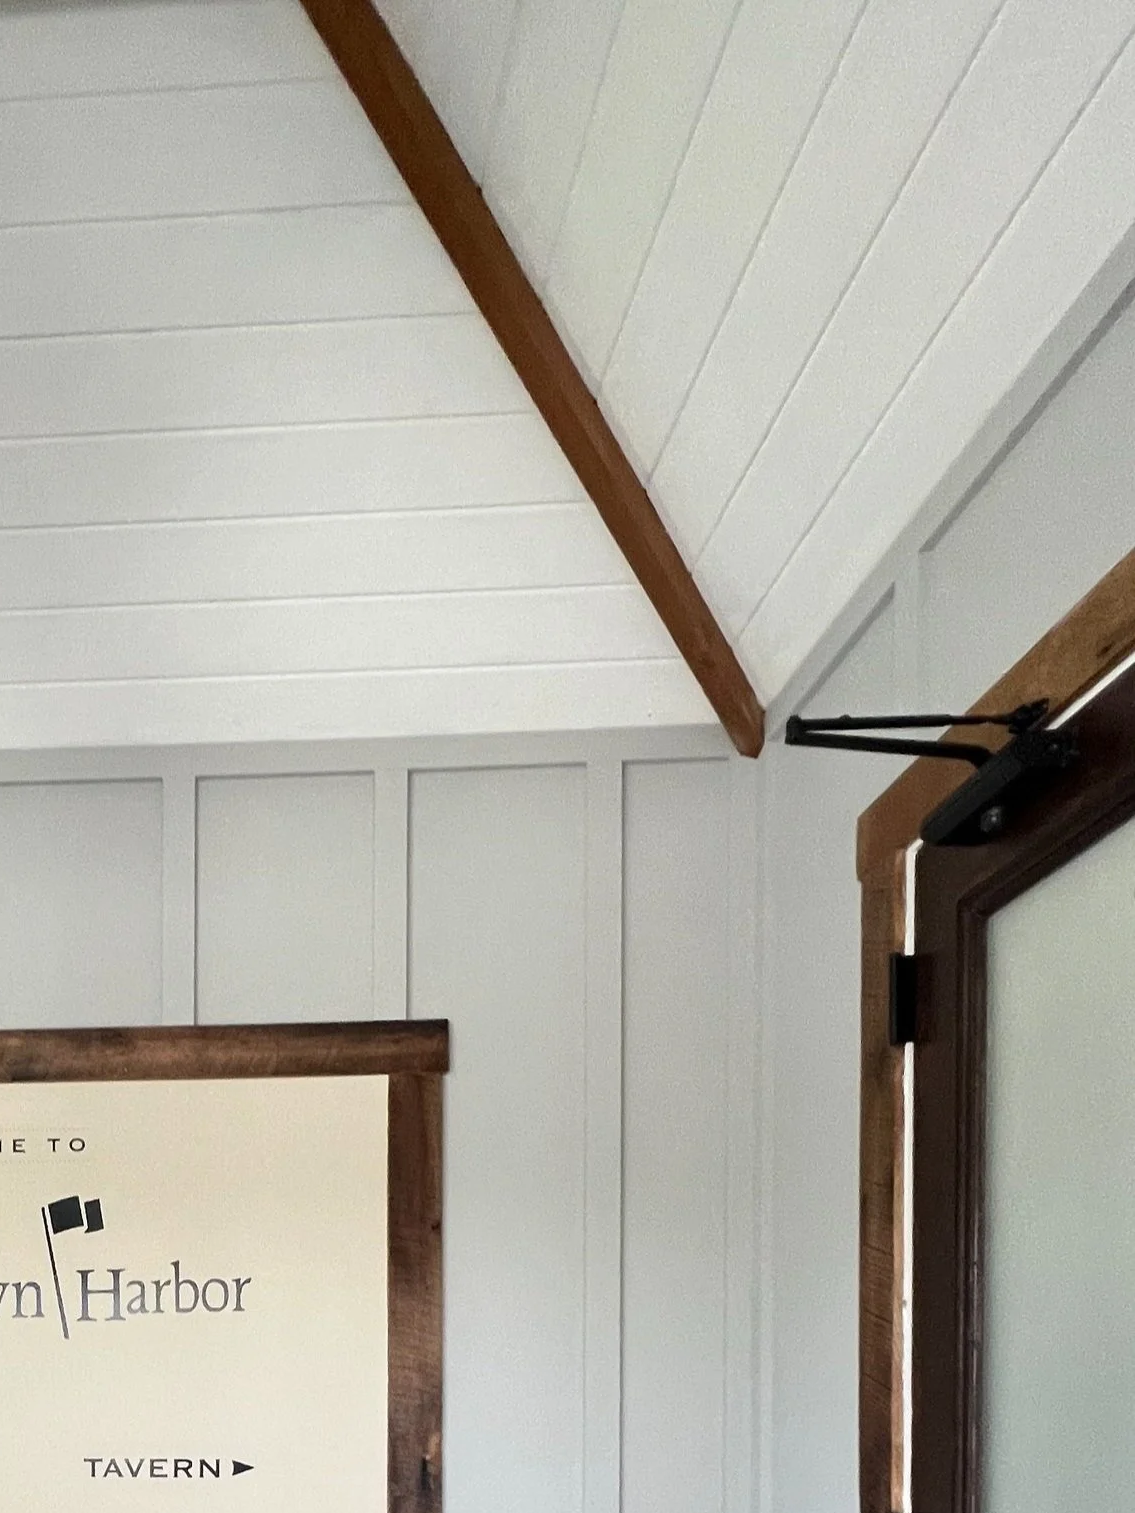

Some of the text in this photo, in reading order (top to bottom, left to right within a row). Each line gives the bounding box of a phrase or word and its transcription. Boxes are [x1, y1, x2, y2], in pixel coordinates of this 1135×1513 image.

[46, 1137, 86, 1153] TO
[75, 1259, 252, 1322] Harbor
[83, 1457, 222, 1479] TAVERN
